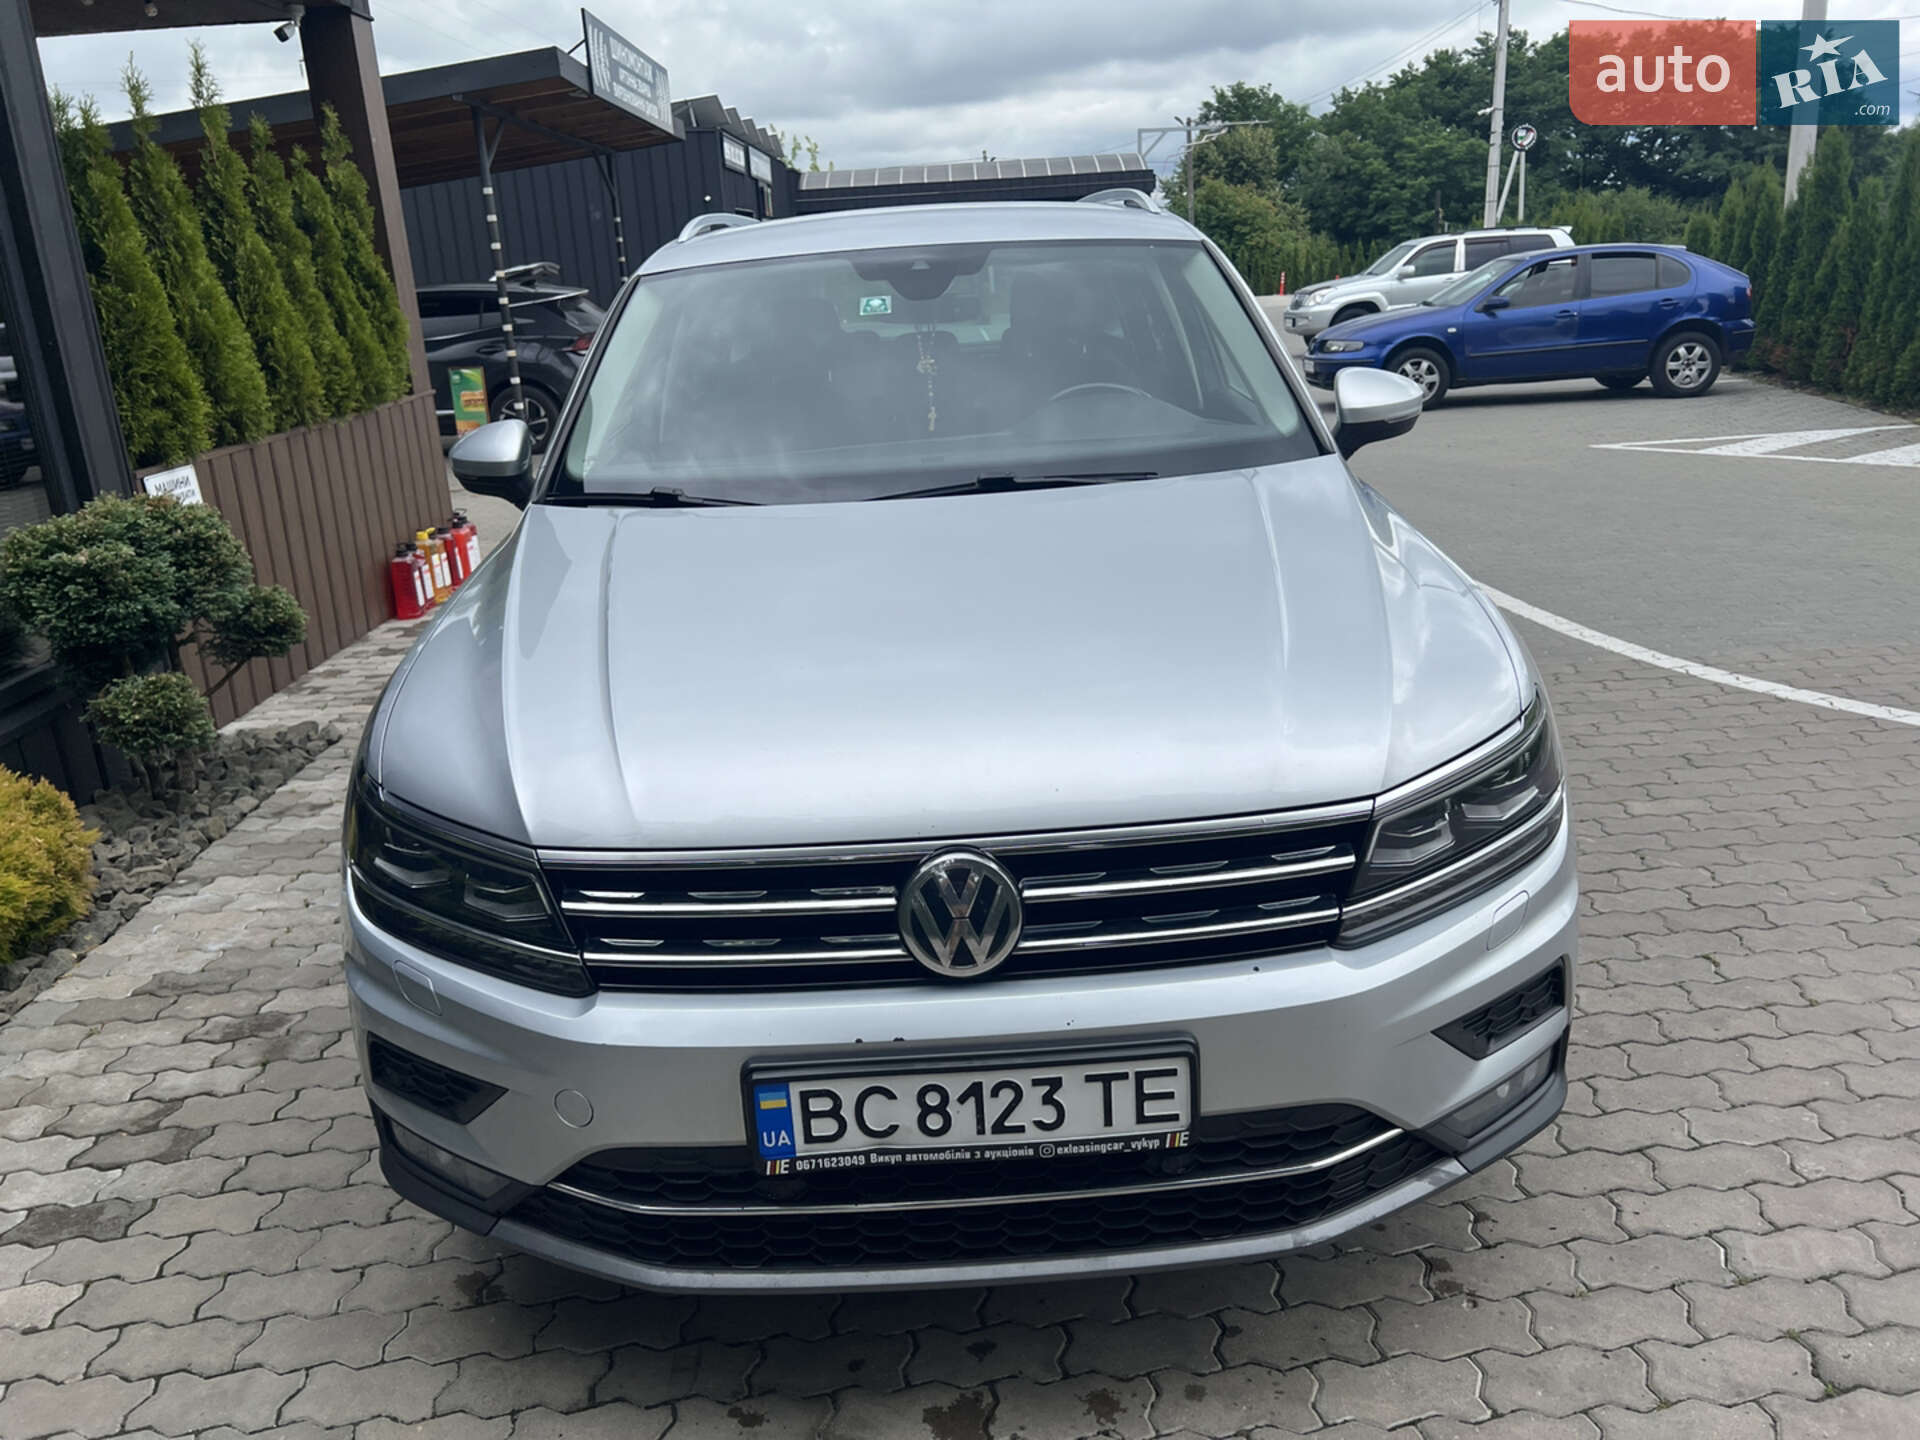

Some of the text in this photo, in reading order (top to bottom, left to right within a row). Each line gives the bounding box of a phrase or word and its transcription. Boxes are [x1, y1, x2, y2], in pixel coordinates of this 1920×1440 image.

[799, 1068, 1180, 1144] BC 8123 TE
[763, 1130, 791, 1147] UA
[796, 1154, 865, 1170] 0671623049
[870, 1151, 902, 1164] Викуп
[905, 1149, 971, 1162] автомобілів
[984, 1147, 1034, 1160] аукціонів
